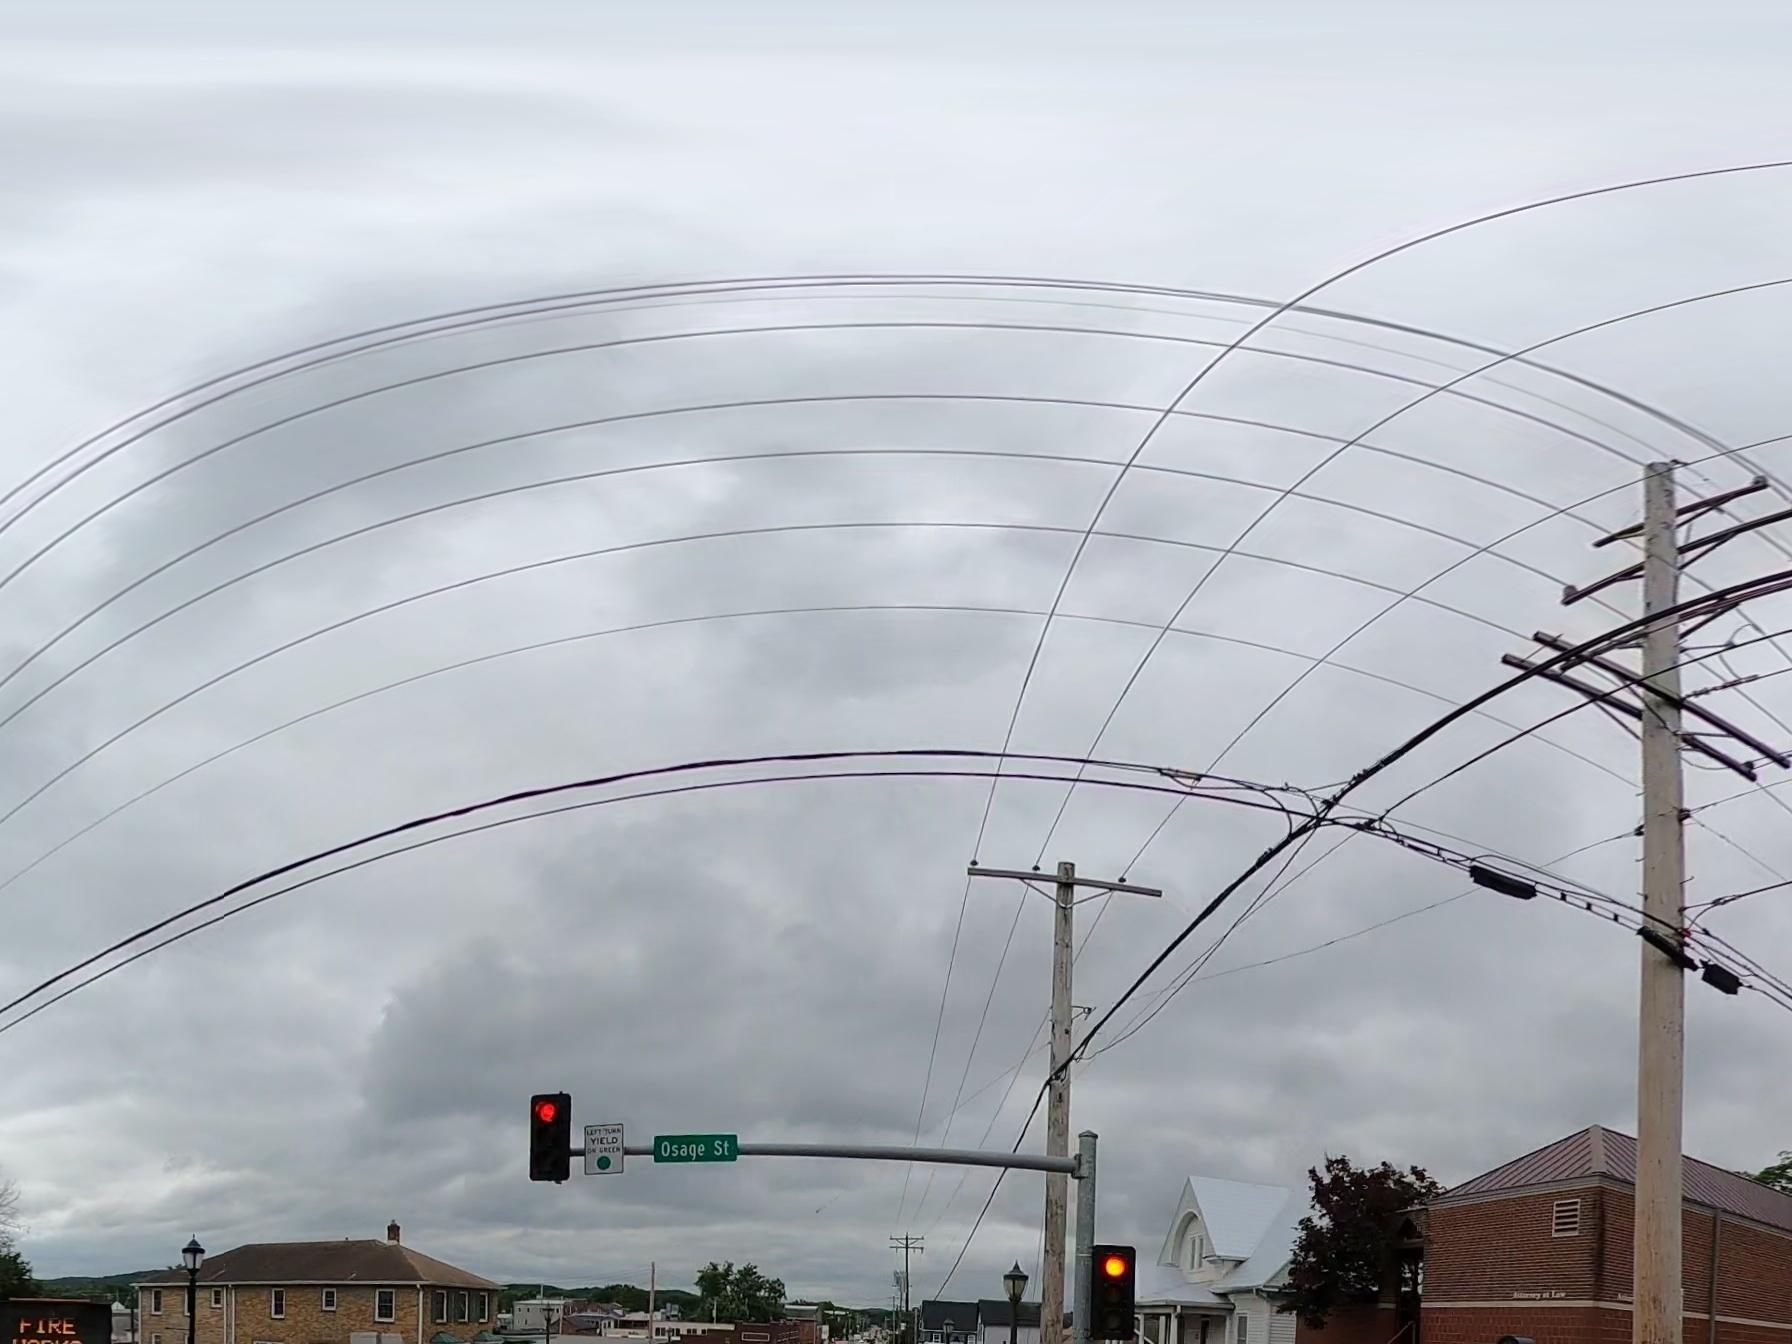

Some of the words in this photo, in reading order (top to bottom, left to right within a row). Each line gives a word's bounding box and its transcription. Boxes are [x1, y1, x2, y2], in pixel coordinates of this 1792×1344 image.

[586, 1128, 602, 1136] LEFT
[604, 1127, 621, 1135] TURN
[590, 1136, 618, 1145] YIELD
[661, 1141, 705, 1160] Osage
[713, 1140, 730, 1156] St
[1551, 1290, 1566, 1298] Law
[19, 1317, 76, 1335] FIRE
